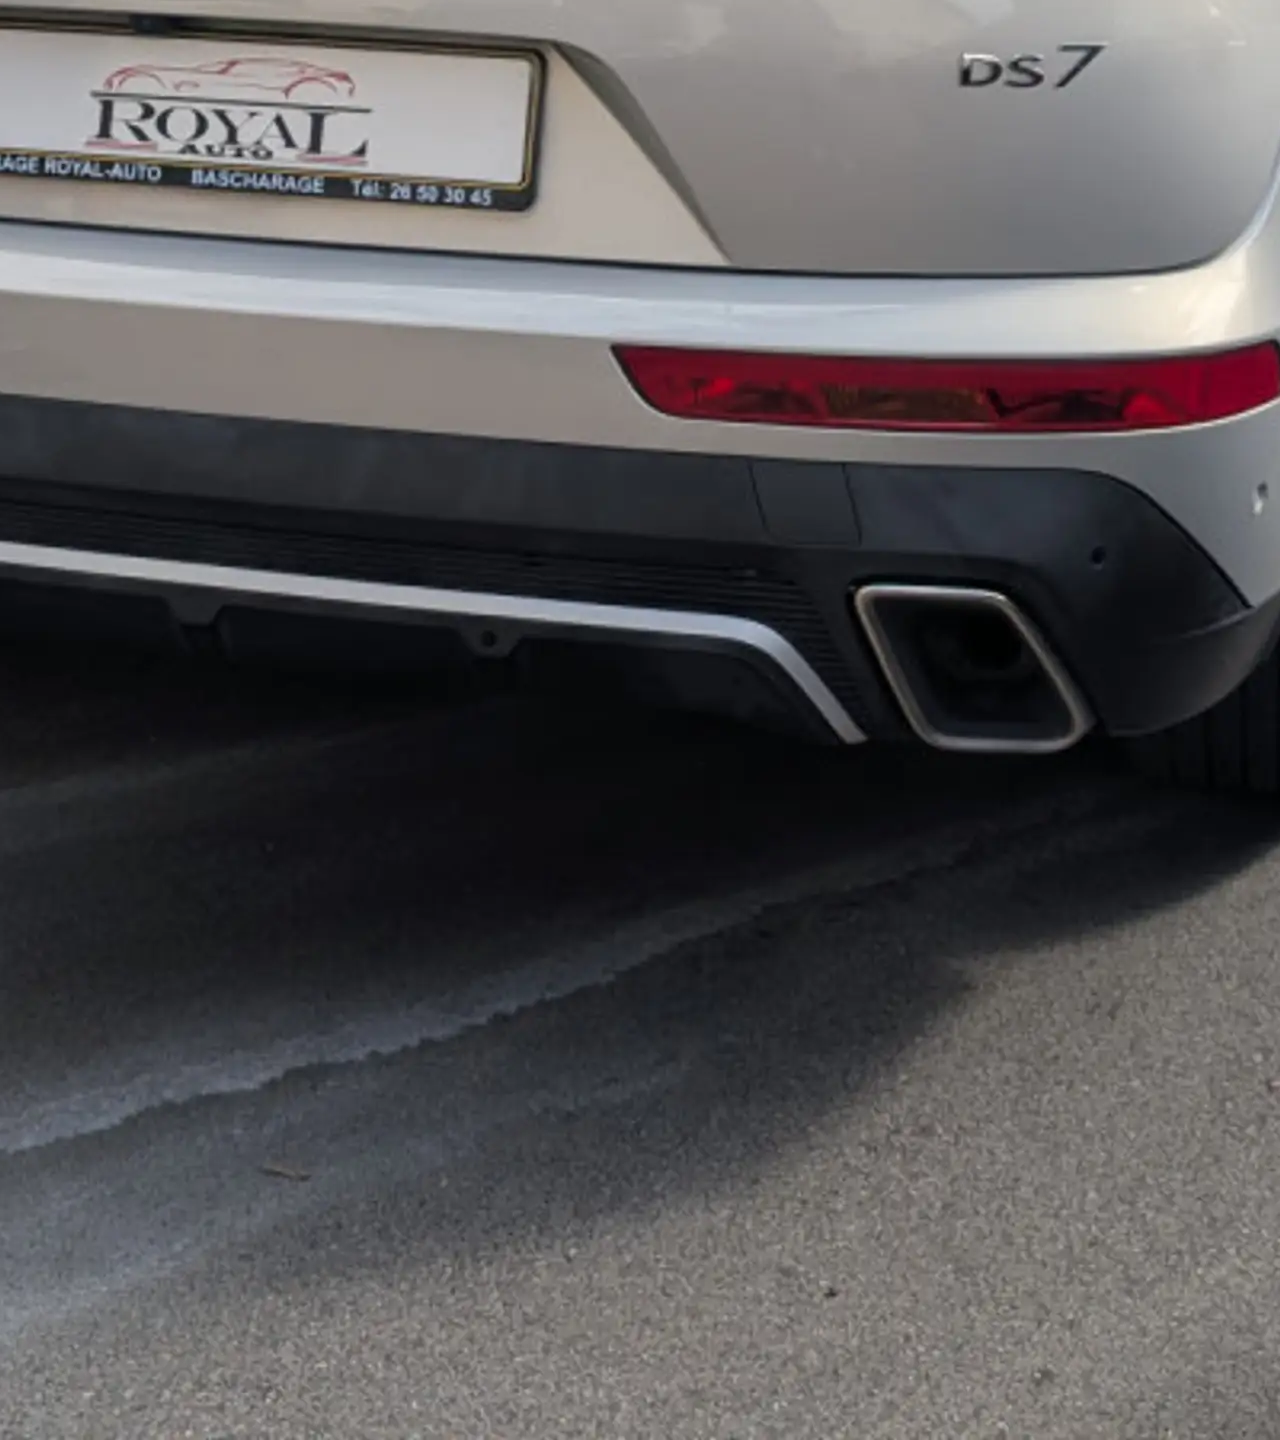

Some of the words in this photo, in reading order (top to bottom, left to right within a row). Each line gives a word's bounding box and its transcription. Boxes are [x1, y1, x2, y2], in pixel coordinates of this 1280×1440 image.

[95, 98, 370, 157] ROYAL
[178, 143, 274, 161] AUTO
[44, 156, 162, 182] ROYAL-AUTO
[191, 169, 324, 194] BASCHARAGE
[416, 185, 437, 203] 50
[444, 187, 465, 205] 30
[470, 189, 492, 207] 45
